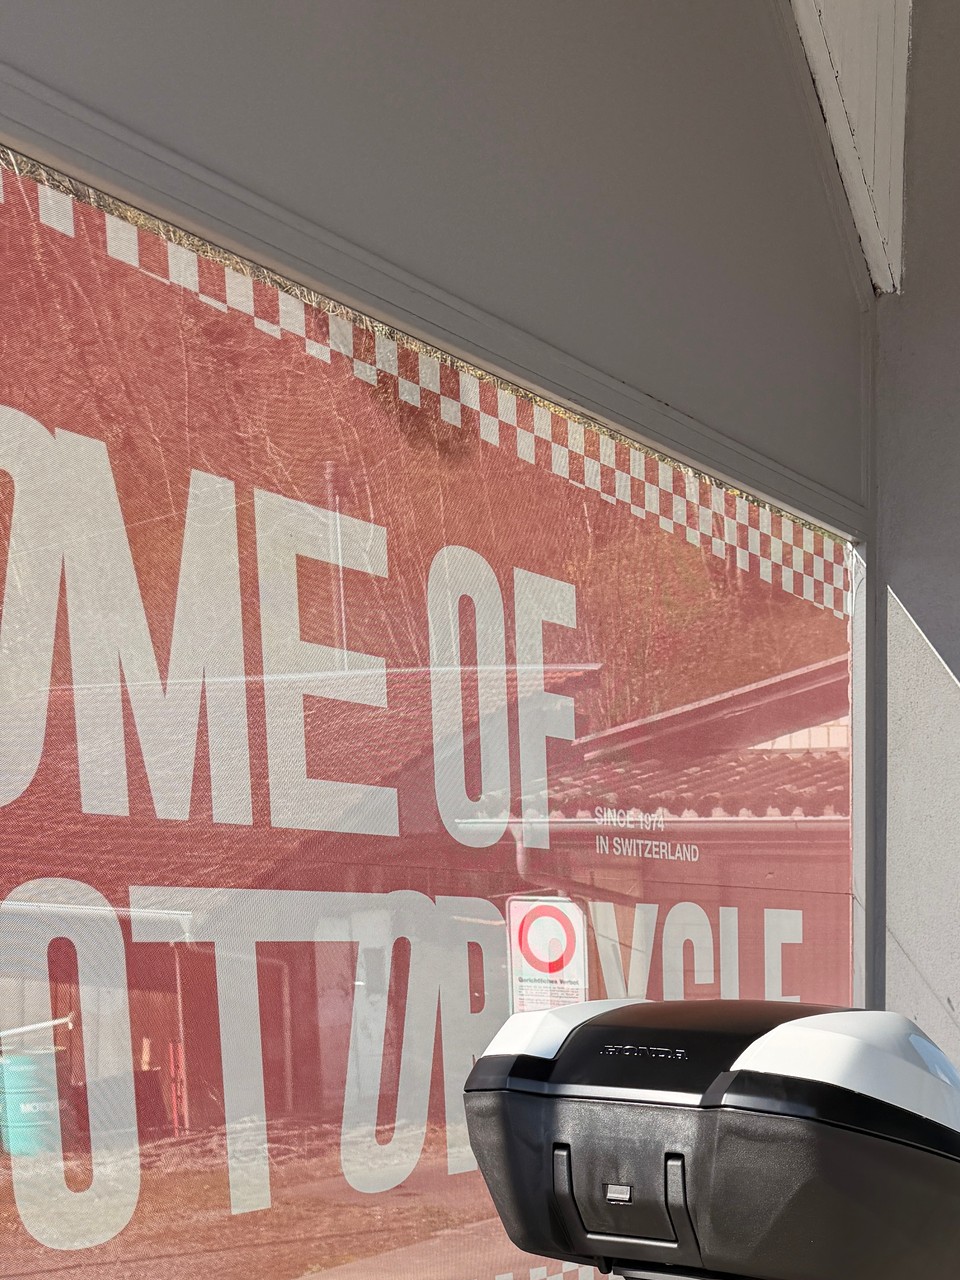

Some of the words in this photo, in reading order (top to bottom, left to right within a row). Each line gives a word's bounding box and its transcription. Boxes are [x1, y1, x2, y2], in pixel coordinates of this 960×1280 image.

[427, 544, 577, 850] OF
[594, 806, 635, 829] SINCE
[639, 812, 665, 832] 1974
[596, 835, 609, 855] IN
[613, 837, 699, 862] SWITZERLAND
[600, 1045, 688, 1061] HONDA
